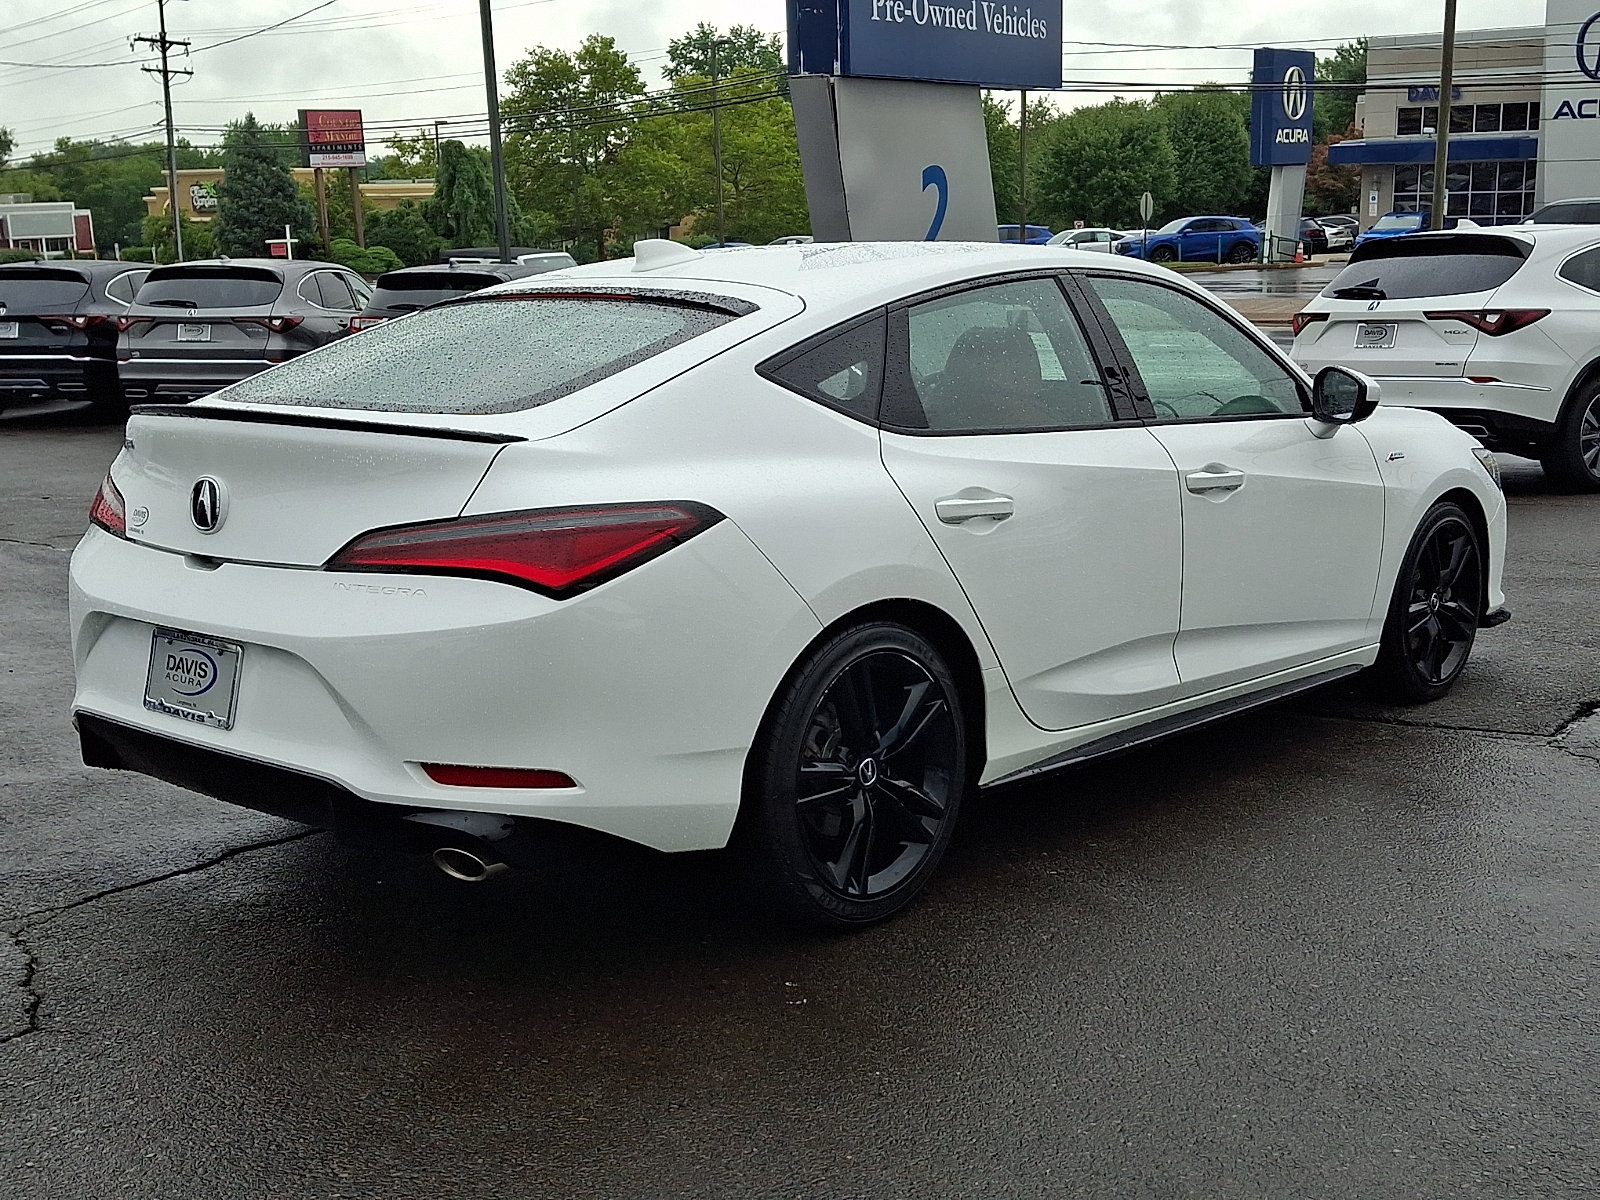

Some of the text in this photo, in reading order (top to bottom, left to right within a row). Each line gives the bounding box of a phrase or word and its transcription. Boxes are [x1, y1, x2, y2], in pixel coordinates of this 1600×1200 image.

[871, 0, 1047, 39] Pre-Owned Vehicles
[1275, 128, 1309, 143] ACURA
[922, 165, 949, 241] 2
[332, 582, 429, 599] INTEGRA
[166, 653, 209, 679] DAVIS
[164, 671, 203, 689] ACURA
[162, 704, 206, 723] DAVIS
